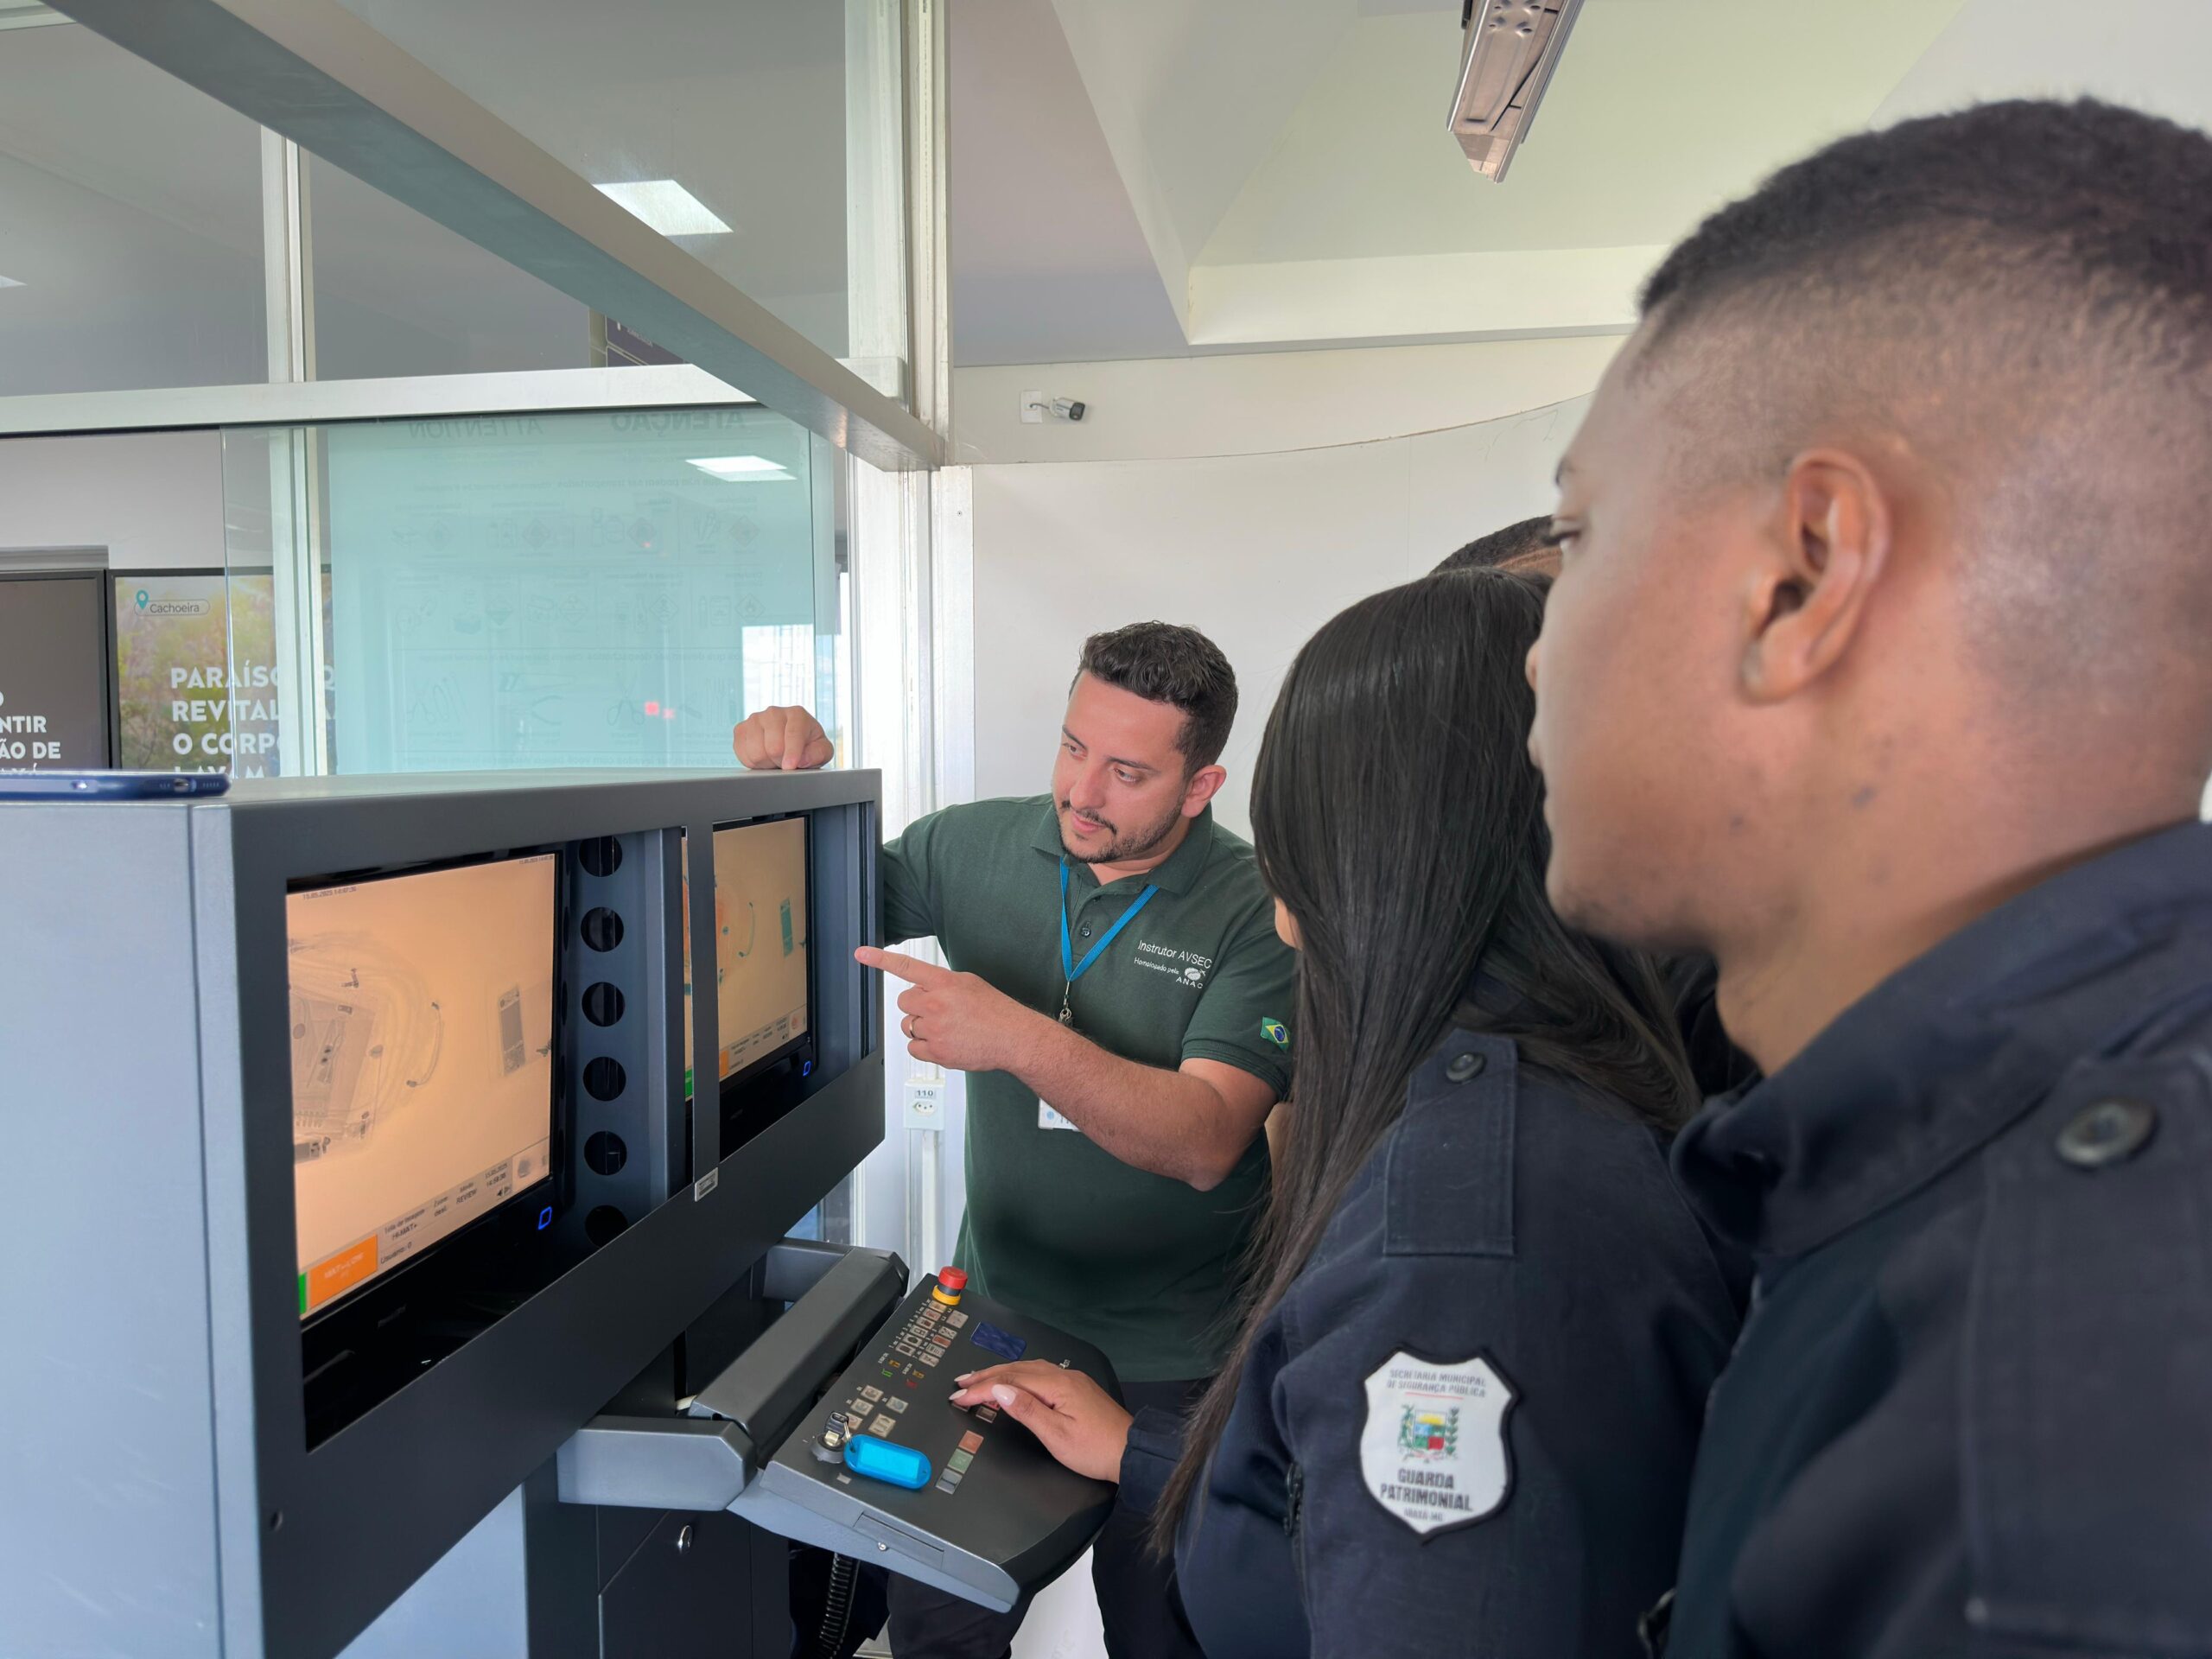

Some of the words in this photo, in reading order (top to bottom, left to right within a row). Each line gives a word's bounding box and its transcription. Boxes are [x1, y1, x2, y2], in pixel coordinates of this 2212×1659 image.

[149, 603, 200, 613] Cachoeira
[173, 700, 279, 721] REVITAL
[33, 741, 60, 759] DE
[174, 733, 193, 754] O
[201, 733, 280, 754] CORP
[1138, 940, 1177, 957] Instrutor
[1178, 950, 1212, 969] AVSEC
[1176, 976, 1204, 988] ANAC
[1398, 1468, 1453, 1489] GUARDA
[1381, 1483, 1472, 1511] PATRIMONIAL
